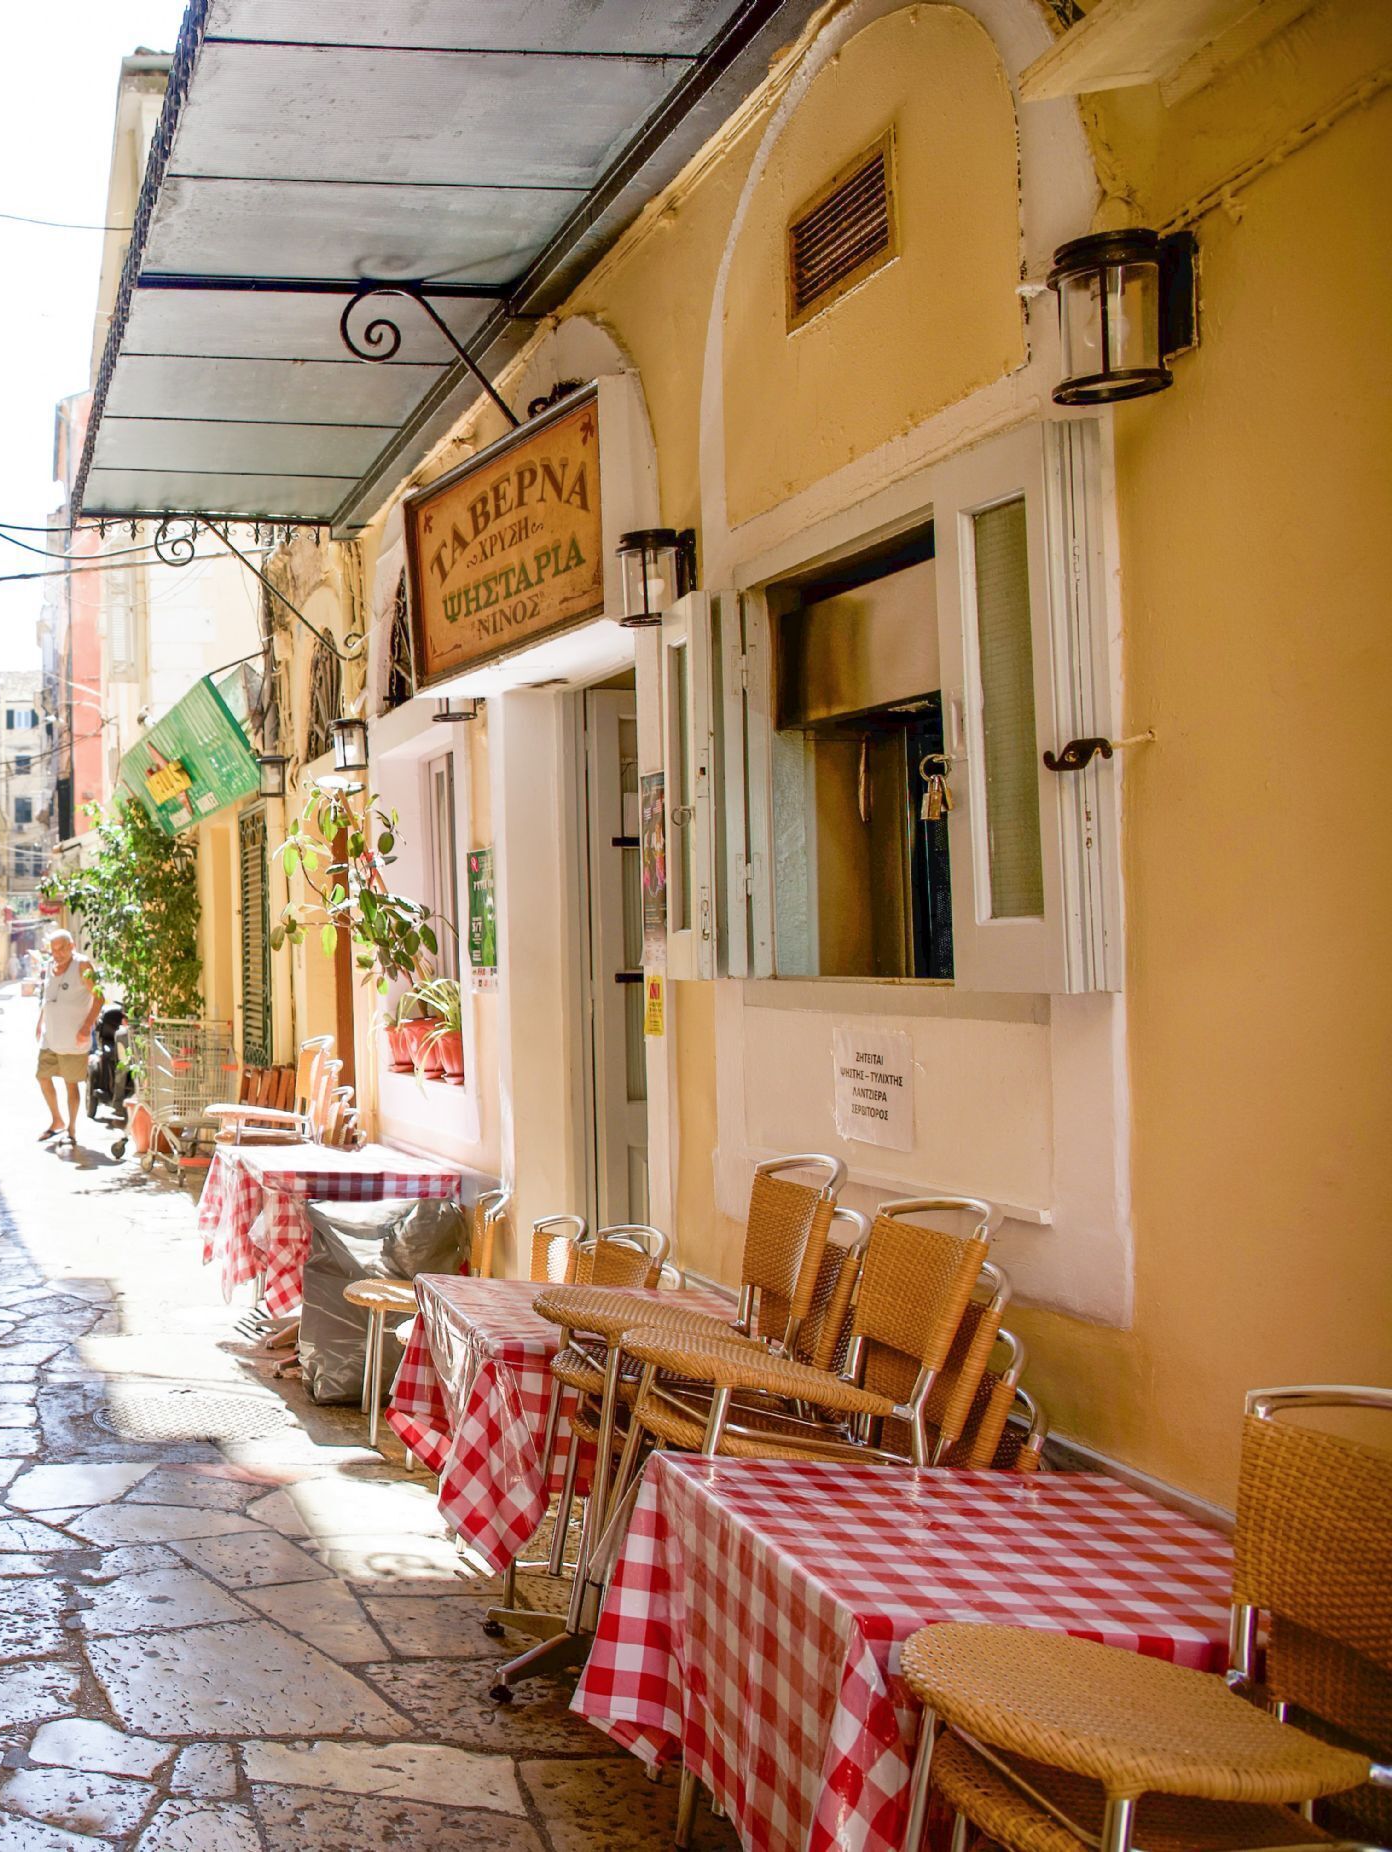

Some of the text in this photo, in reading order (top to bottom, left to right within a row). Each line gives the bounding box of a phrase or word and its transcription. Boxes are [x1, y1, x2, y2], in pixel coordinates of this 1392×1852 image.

[430, 456, 591, 588] ΤΑΒΕΡΝΑ
[478, 515, 529, 565] ΧΡΥΣΗ
[442, 531, 586, 624] ΨΗΣΤΑΡΙΑ
[856, 1052, 884, 1065] ΖΗΤΕΙΤΑΙ
[840, 1066, 864, 1080] ΨΗΣΤΗΣ
[870, 1072, 903, 1087] ΤΥΛΙΧΤΗΣ
[851, 1104, 888, 1120] ΣΕΡΒΙΤΟΡΟΣ
